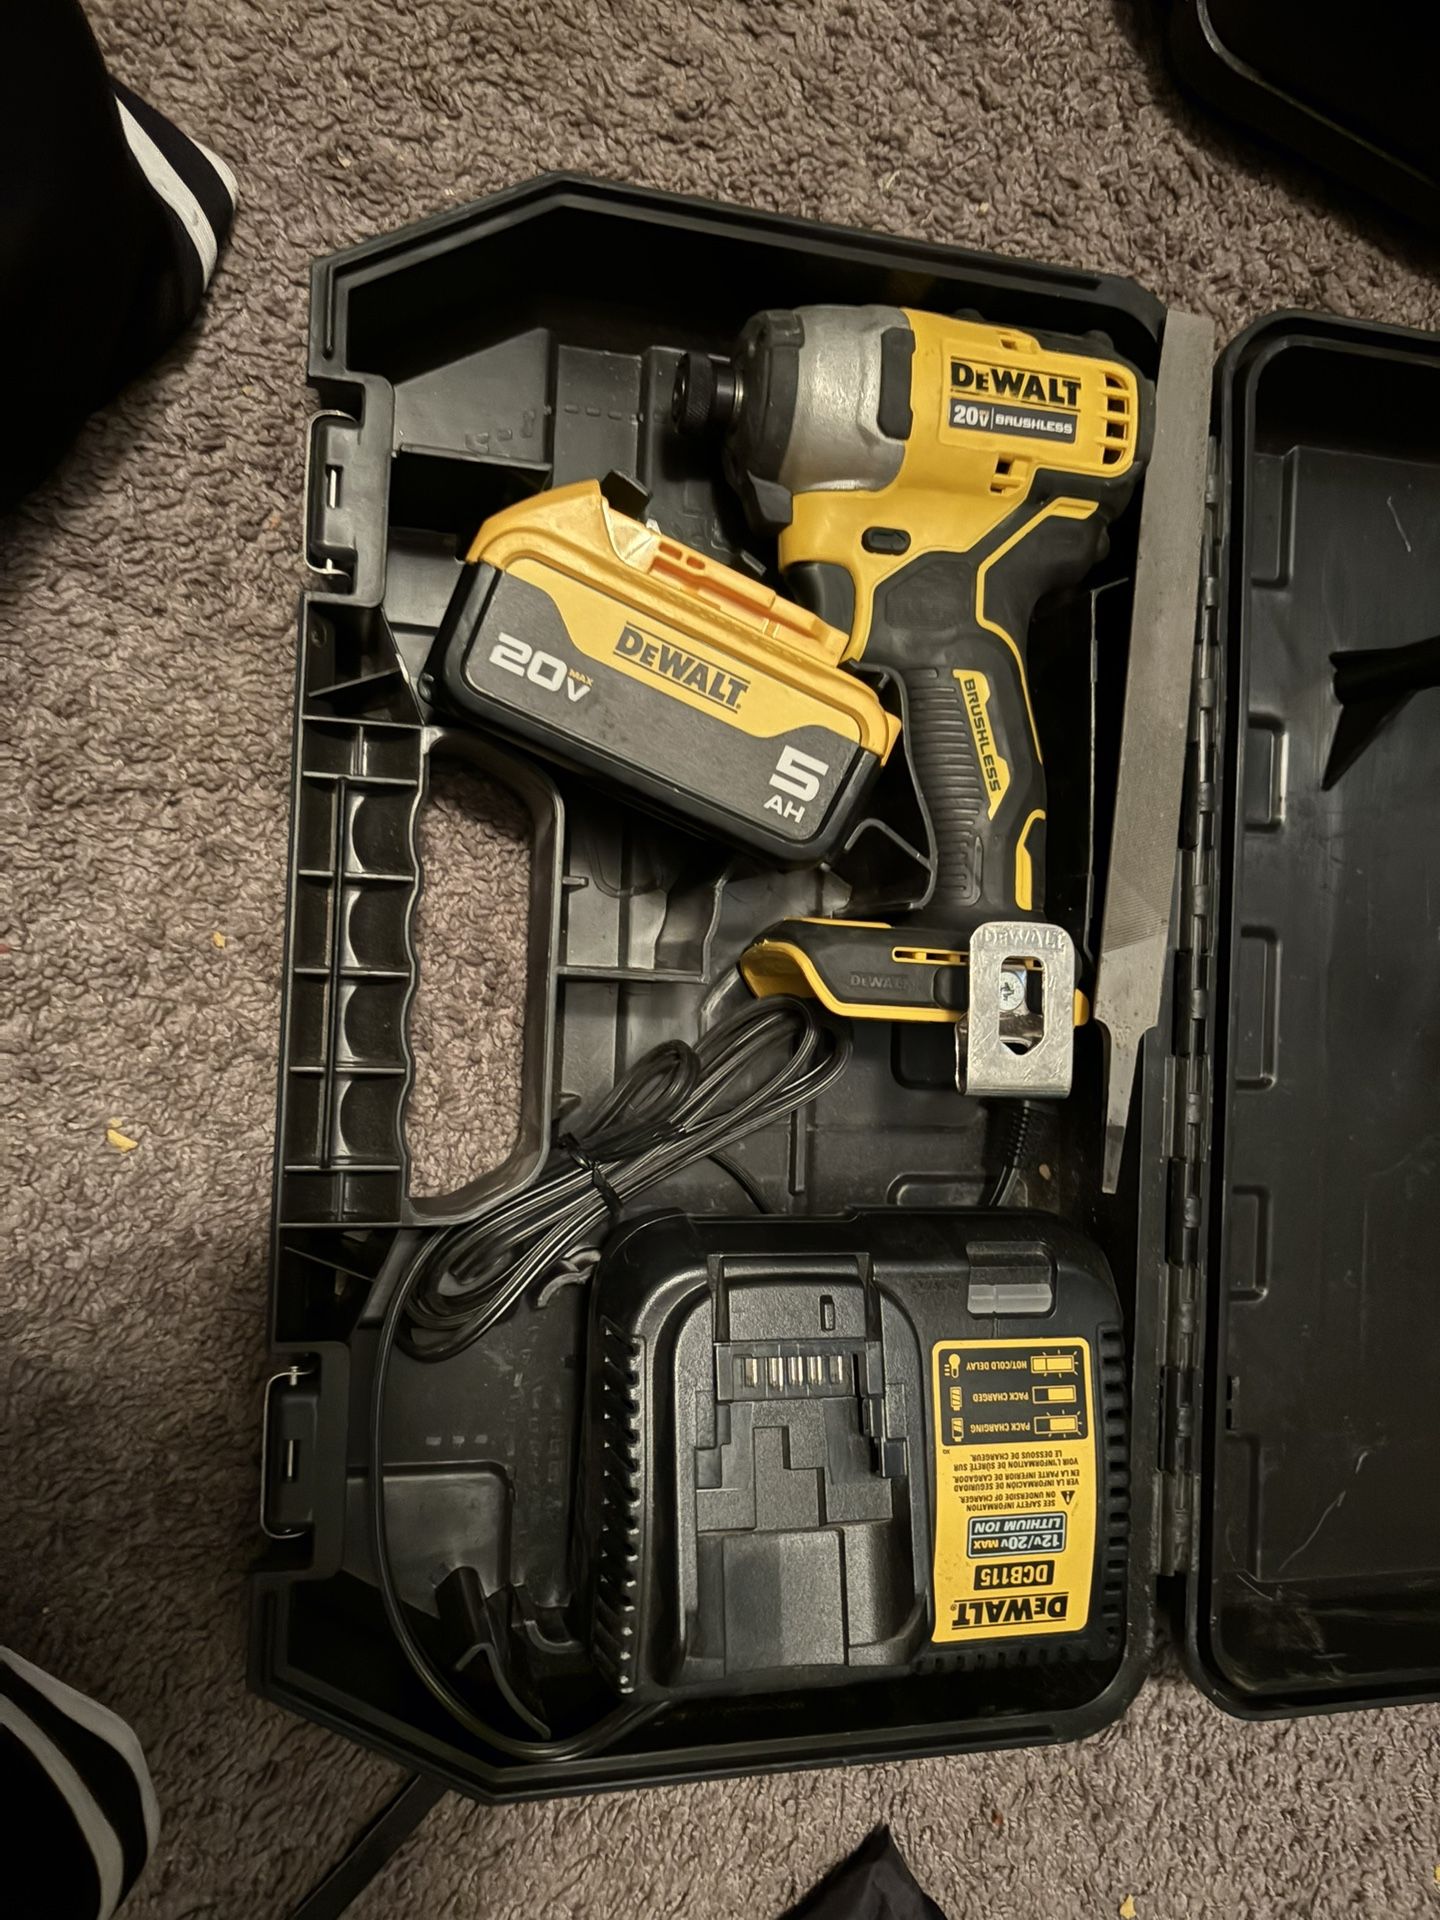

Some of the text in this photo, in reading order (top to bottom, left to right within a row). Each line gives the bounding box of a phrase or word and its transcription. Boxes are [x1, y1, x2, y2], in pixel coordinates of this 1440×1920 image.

[995, 413, 1073, 434] BRUSHLESS
[568, 668, 594, 688] MAX
[963, 678, 1001, 792] BRUSHLESS
[769, 745, 829, 801] 5
[763, 795, 806, 823] AH
[966, 1360, 1027, 1371] HOT/COLD DELAY
[972, 1392, 1029, 1402] PACK CHARGED
[970, 1422, 1030, 1433] PACK CHARGING
[1011, 1452, 1019, 1460] DE
[1021, 1450, 1053, 1459] DESSOUS
[1054, 1450, 1062, 1458] LE
[997, 1461, 1006, 1469] DE
[1007, 1458, 1061, 1469] L'INFORMATION
[1062, 1457, 1078, 1466] VOIR
[953, 1463, 968, 1472] SUR
[994, 1473, 1003, 1481] DE
[1005, 1471, 1036, 1481] INFERIOR
[1038, 1470, 1059, 1479] PARTE
[1060, 1469, 1069, 1477] LA
[1071, 1469, 1080, 1477] EN
[995, 1482, 1004, 1490] DE
[1066, 1478, 1079, 1486] VER
[953, 1483, 993, 1492] SEGURIDAD
[958, 1491, 1056, 1503] ON UNDERSIDE OF CHARGER.
[966, 1499, 1056, 1511] SEE SAFETY INFORMATION
[974, 1517, 1061, 1533] LITHIUM ION
[973, 1539, 999, 1549] MAX
[980, 1564, 1048, 1586] DCB115
